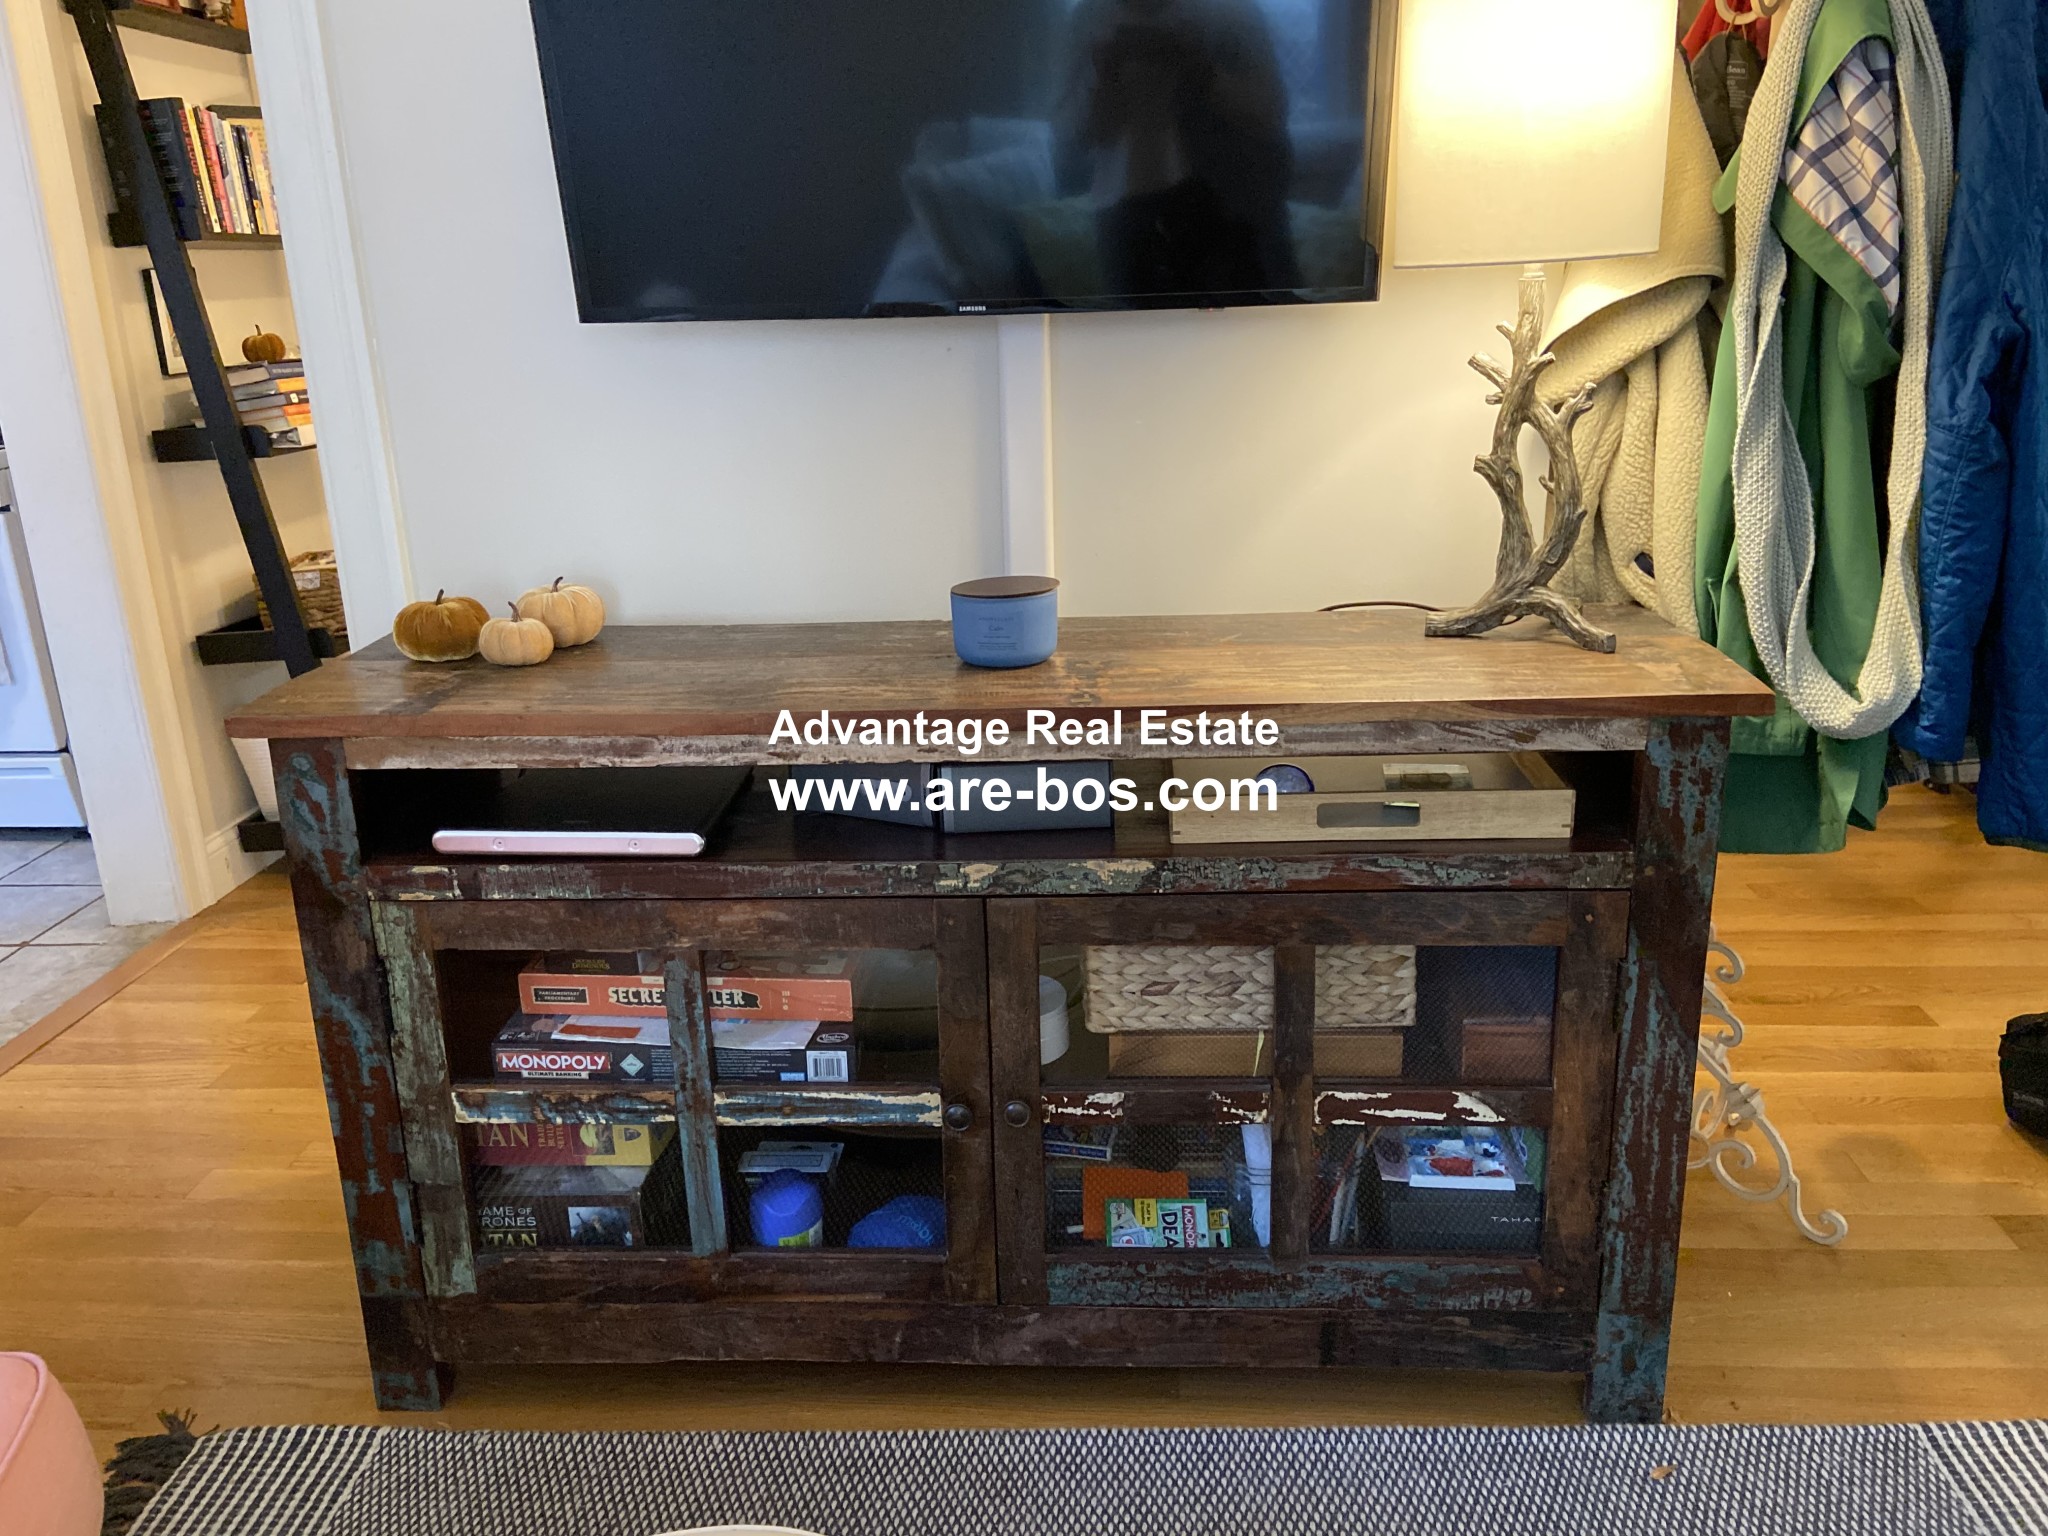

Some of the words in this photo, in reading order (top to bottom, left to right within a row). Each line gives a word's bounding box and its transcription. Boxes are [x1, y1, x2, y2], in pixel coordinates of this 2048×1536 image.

[608, 986, 666, 1004] SECRE
[709, 988, 745, 1005] LER
[501, 1054, 606, 1070] MONOPOLY
[479, 1206, 514, 1216] AME
[518, 1206, 532, 1216] OF
[487, 1232, 538, 1247] TAN
